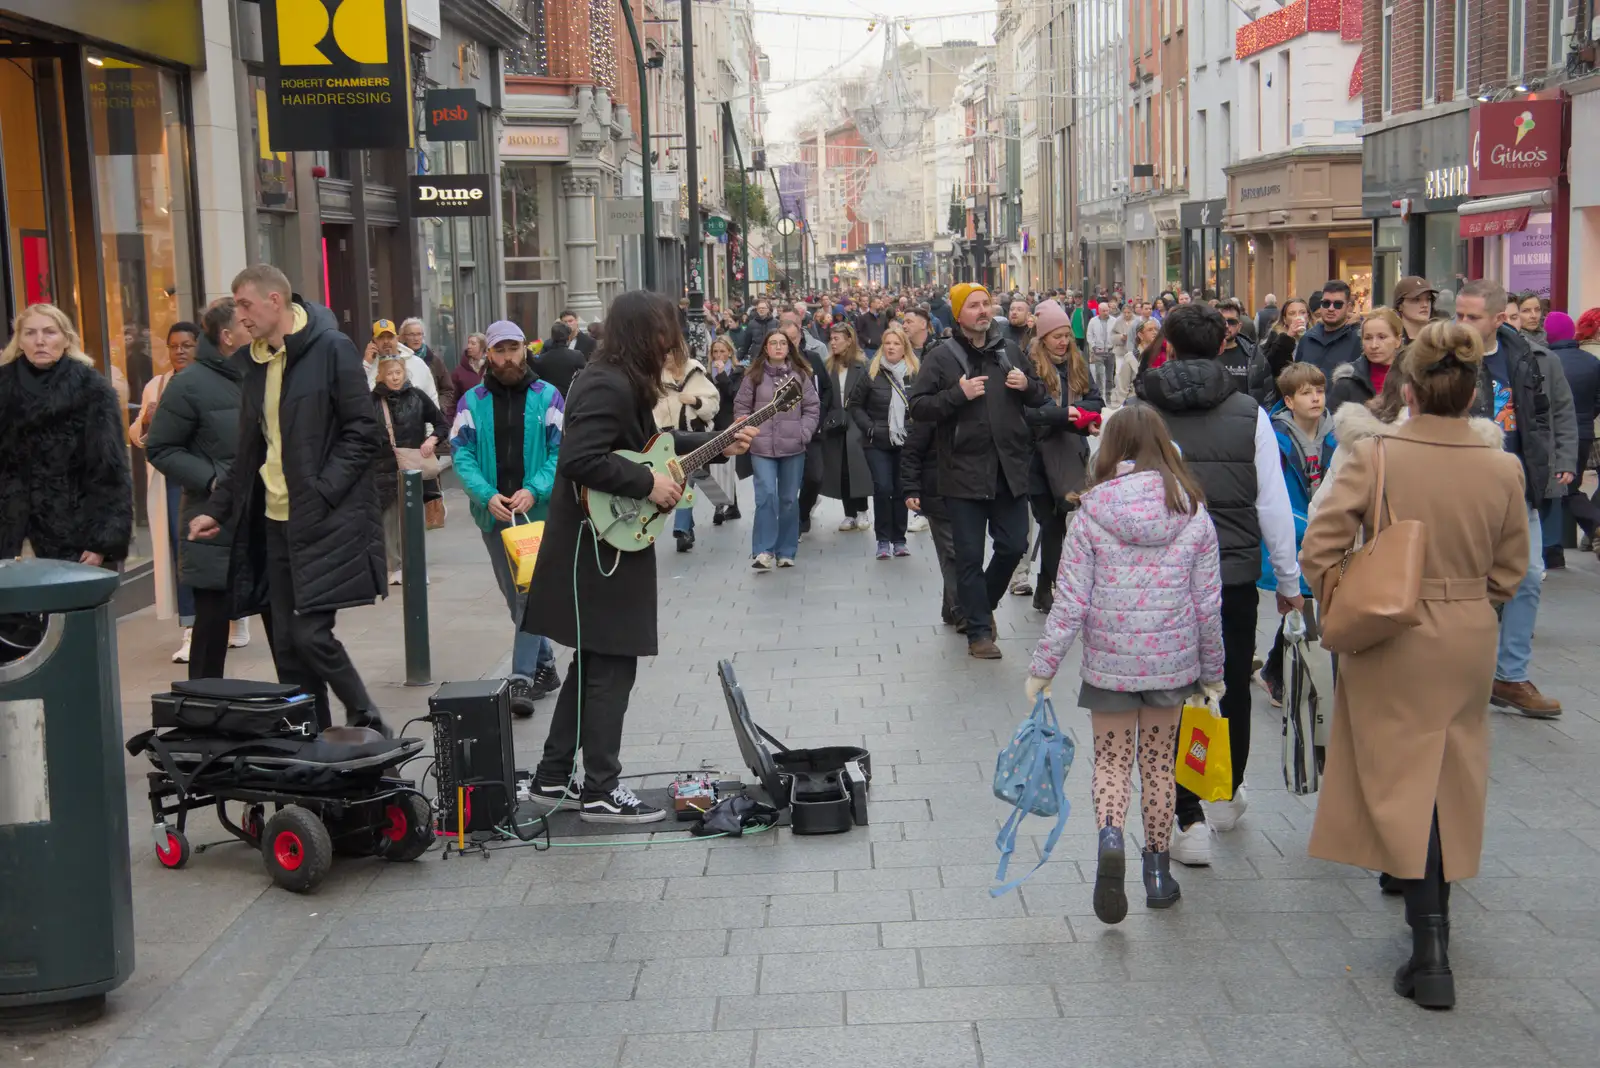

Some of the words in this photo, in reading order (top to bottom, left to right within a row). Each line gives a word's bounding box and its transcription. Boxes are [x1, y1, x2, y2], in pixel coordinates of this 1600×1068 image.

[281, 79, 324, 88] ROBERT
[326, 77, 390, 87] CHAMBERS
[281, 92, 392, 105] HAIRDRESSING
[432, 104, 469, 126] ptsb
[507, 135, 560, 146] BOODLES
[1491, 144, 1548, 166] Gino's
[418, 186, 484, 200] Dune
[611, 211, 644, 219] BOODLE
[1190, 741, 1207, 762] LEGO
